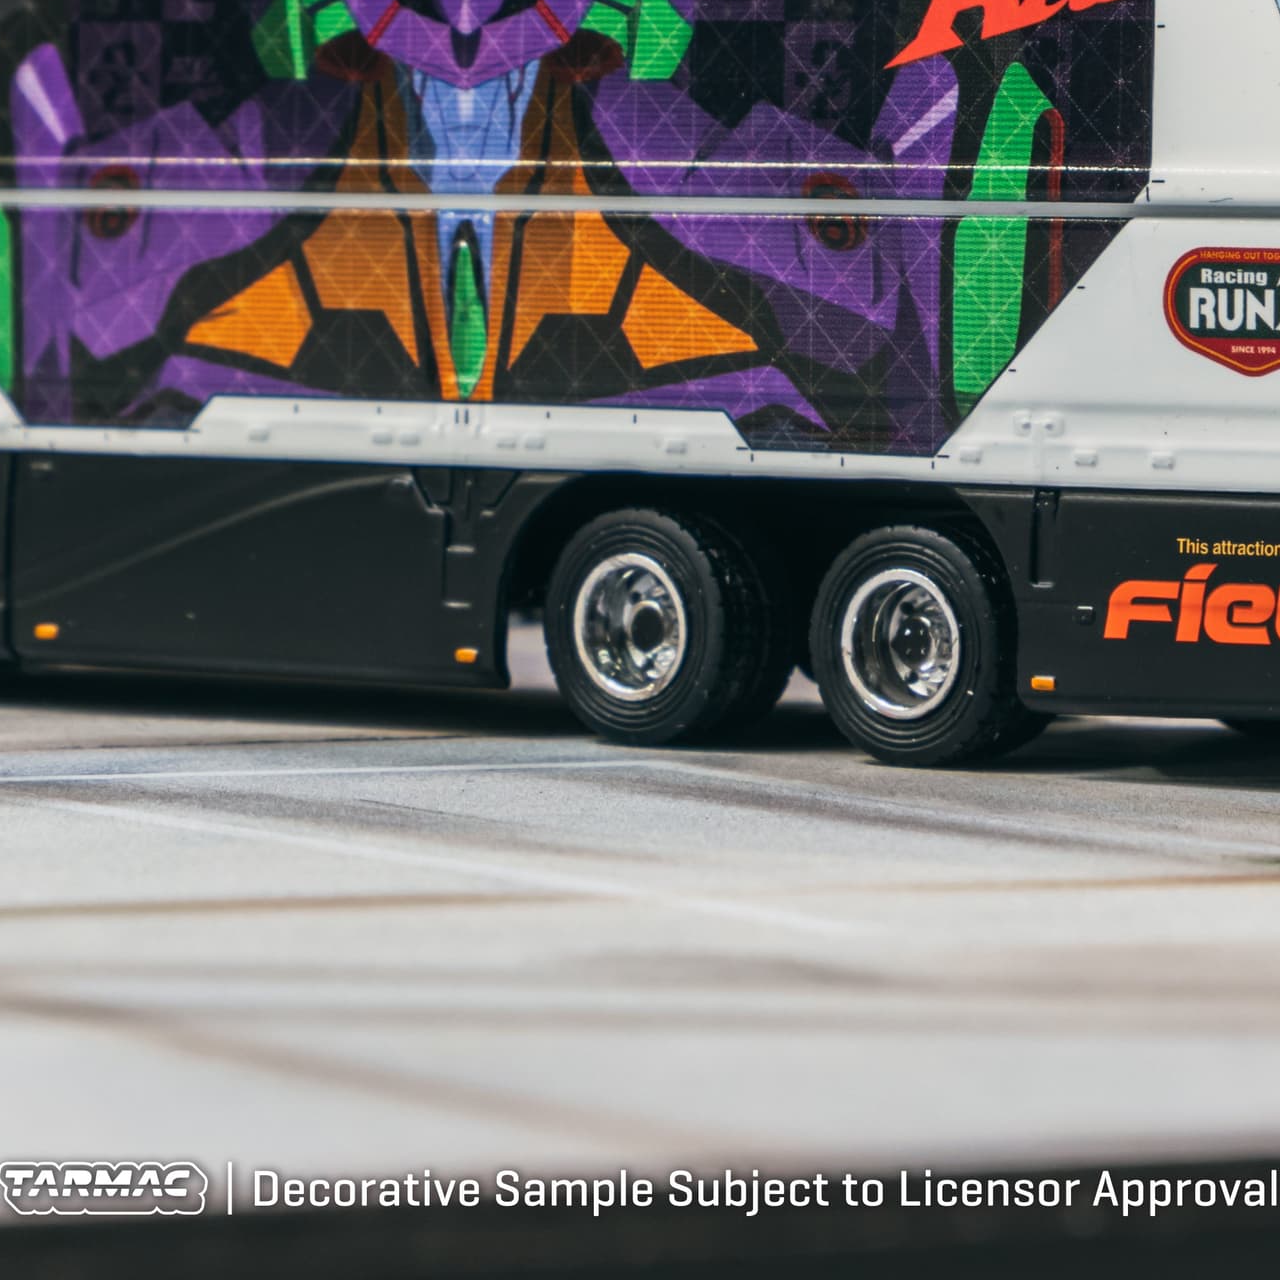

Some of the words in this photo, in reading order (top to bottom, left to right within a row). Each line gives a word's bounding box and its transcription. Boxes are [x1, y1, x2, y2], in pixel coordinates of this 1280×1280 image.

[1200, 251, 1240, 260] HANGING
[1243, 251, 1261, 260] OUT
[1200, 268, 1268, 286] Racing
[1231, 345, 1255, 354] SINCE
[1257, 345, 1277, 354] 1994
[1176, 538, 1209, 555] This
